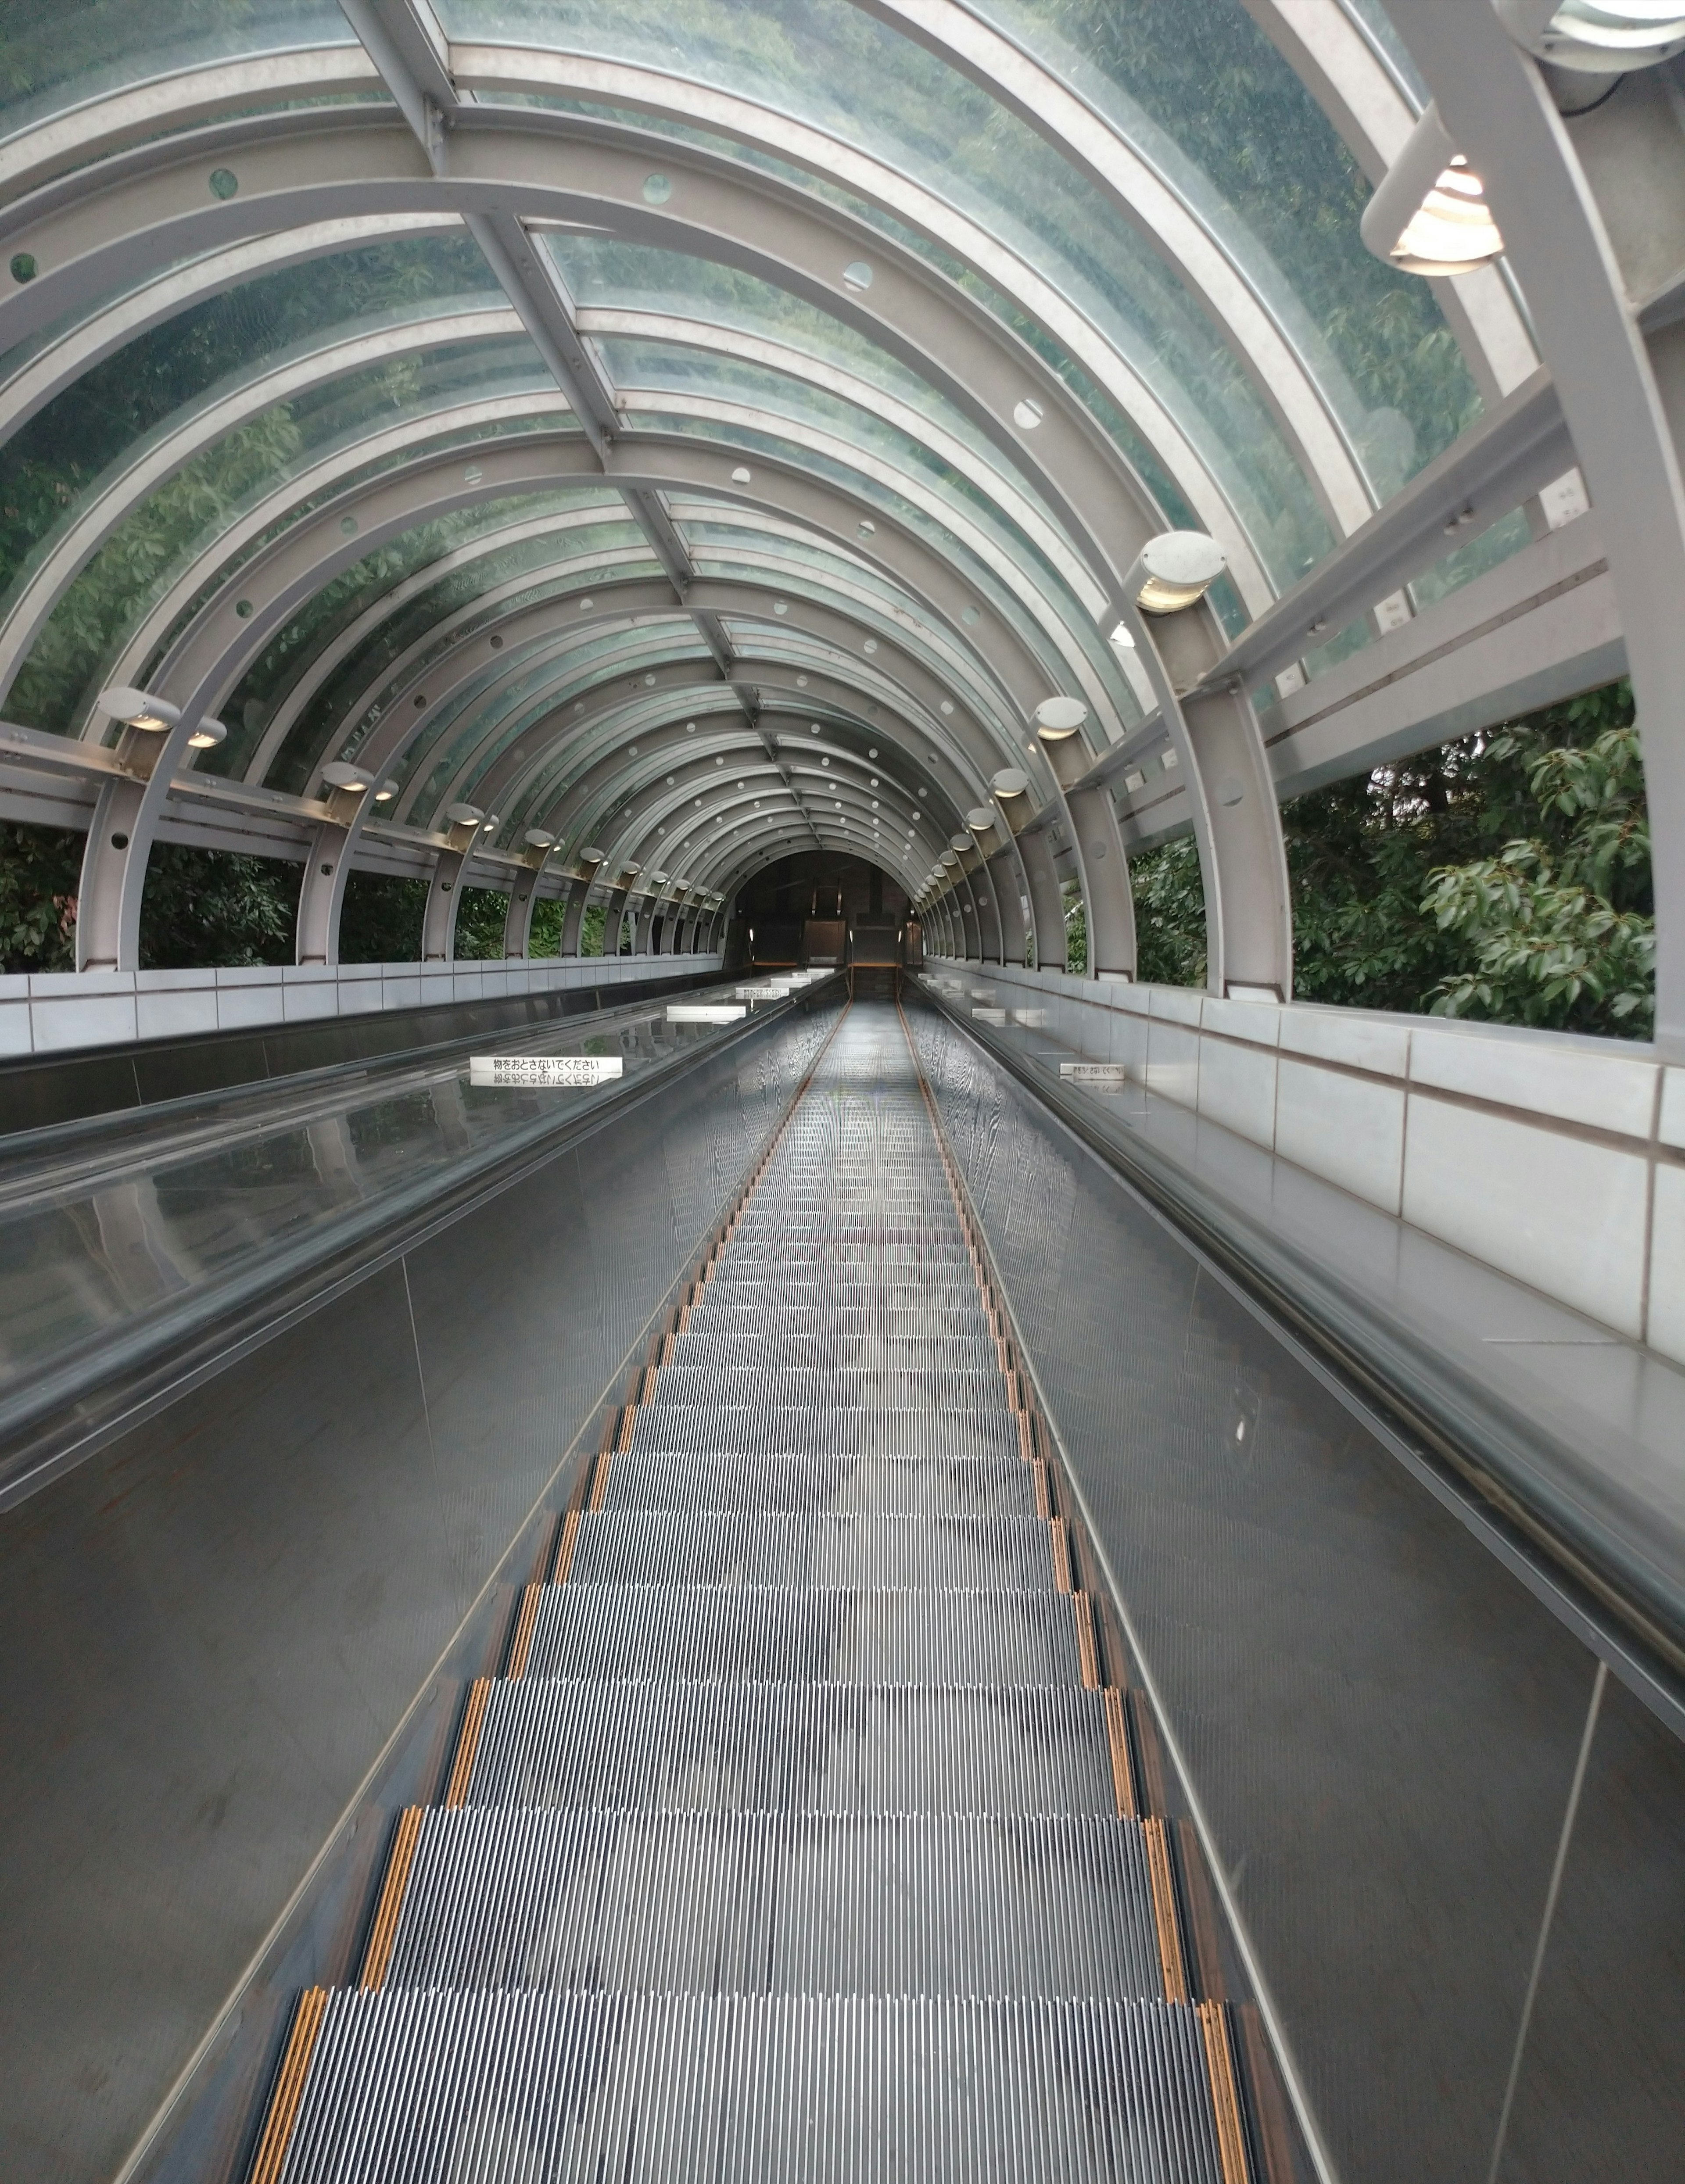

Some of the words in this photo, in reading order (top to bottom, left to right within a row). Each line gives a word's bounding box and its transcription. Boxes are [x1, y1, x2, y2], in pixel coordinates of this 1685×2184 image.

[494, 1059, 599, 1071] 物をおとさないでください
